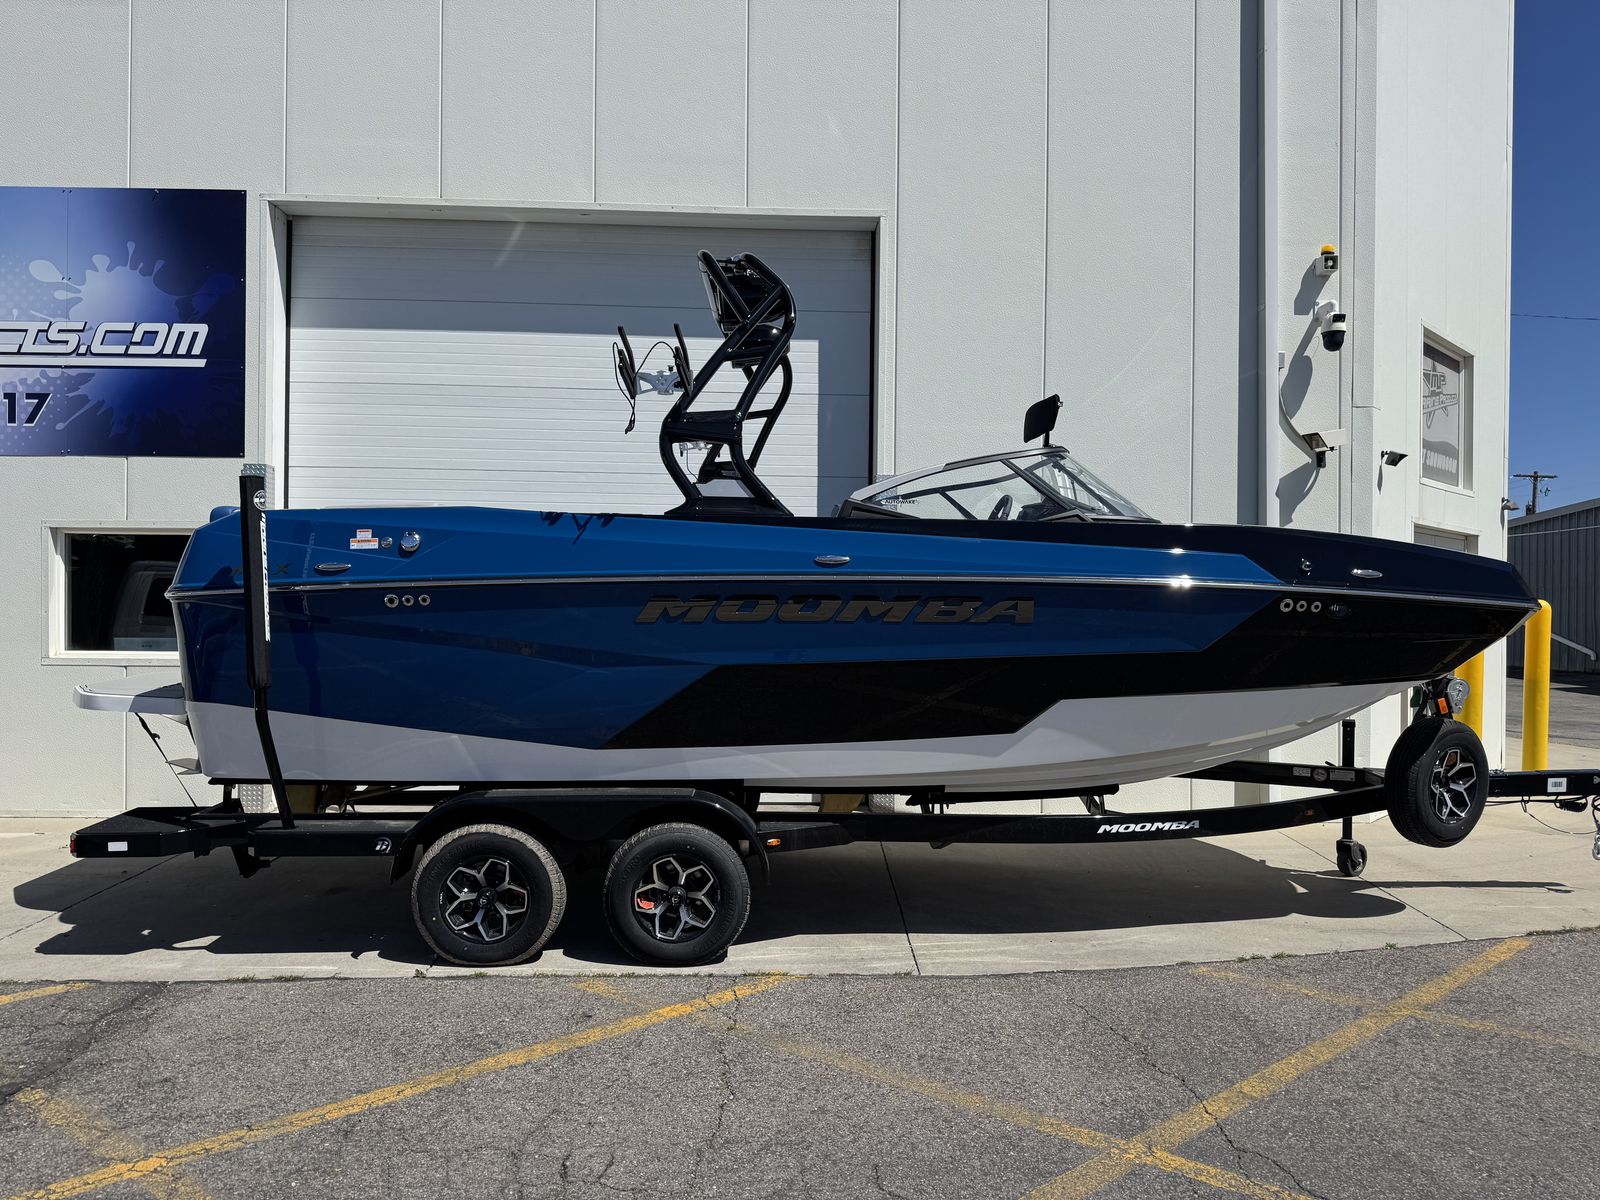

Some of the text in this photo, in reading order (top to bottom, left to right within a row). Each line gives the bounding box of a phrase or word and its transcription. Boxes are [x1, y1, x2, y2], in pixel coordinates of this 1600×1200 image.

[2, 391, 53, 427] 17
[635, 595, 1035, 624] MOOMBA
[1097, 820, 1200, 834] MOOMBA
